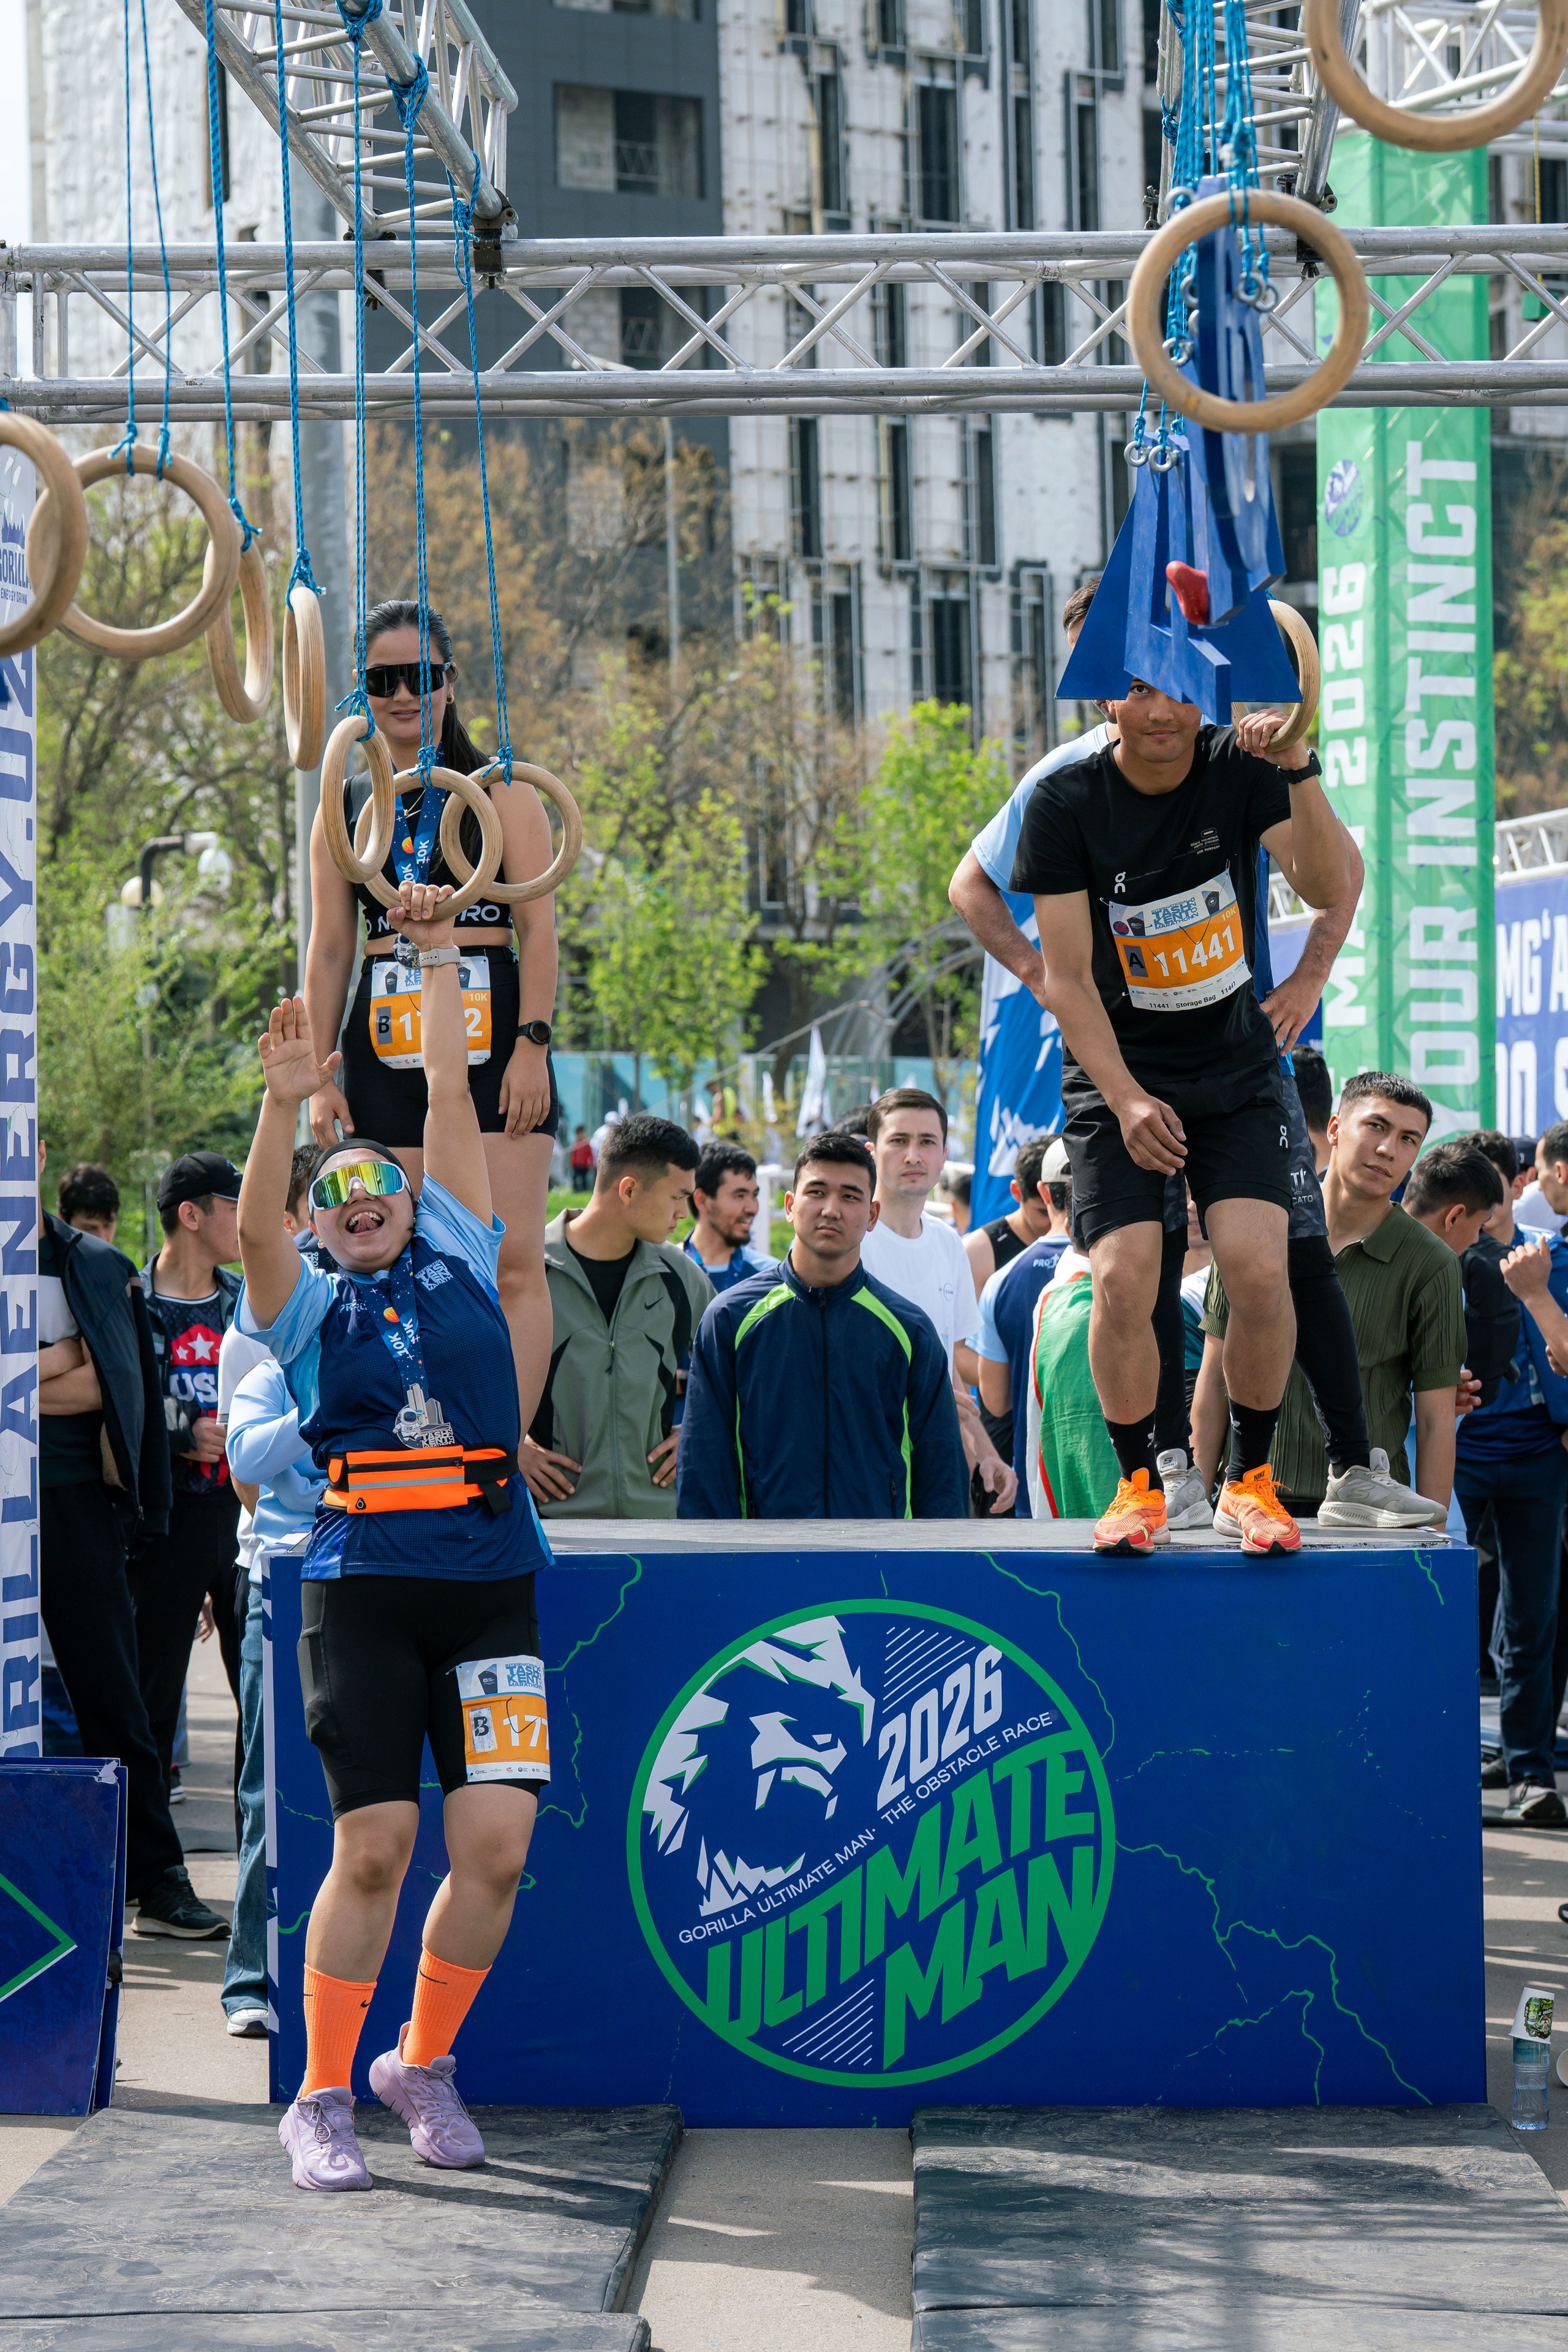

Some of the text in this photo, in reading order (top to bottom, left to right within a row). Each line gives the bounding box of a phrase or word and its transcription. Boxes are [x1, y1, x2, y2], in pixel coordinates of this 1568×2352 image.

[0, 548, 31, 589] ORILLA
[1, 587, 16, 601] ENERGY
[1322, 561, 1367, 788] 2026
[1405, 441, 1480, 1147] YOUR INSTINCT
[417, 840, 430, 864] 10K
[1152, 900, 1189, 913] INTERNATIONAL
[1152, 897, 1199, 920] TASH 2026
[1153, 910, 1191, 927] KENT
[1221, 906, 1237, 921] 10K
[1155, 916, 1195, 930] MARATHON
[1128, 951, 1145, 968] A
[1154, 925, 1235, 977] 11441
[469, 993, 488, 1001] 10K
[1175, 1000, 1202, 1009] Storage
[1203, 994, 1216, 1003] Bag
[1221, 981, 1236, 995] 11441
[379, 1016, 390, 1034] B
[0, 646, 40, 1757] RILLAENERGY.UZ
[388, 1332, 409, 1356] 10K
[170, 1373, 218, 1403] US
[1254, 1470, 1265, 1481] NIKE
[505, 1665, 540, 1677] TASH
[507, 1673, 540, 1686] KENT
[473, 1716, 489, 1737] B
[877, 1645, 1002, 1811] 2026
[679, 1907, 756, 1943] GORILLA
[757, 1859, 836, 1913] ULTIMATE
[881, 1796, 916, 1825] THE
[916, 1736, 1001, 1799] OBSTACLE
[1001, 1711, 1053, 1743] RACE
[706, 1732, 1095, 2038] ULTIMATE
[883, 1845, 1094, 2070] MAN
